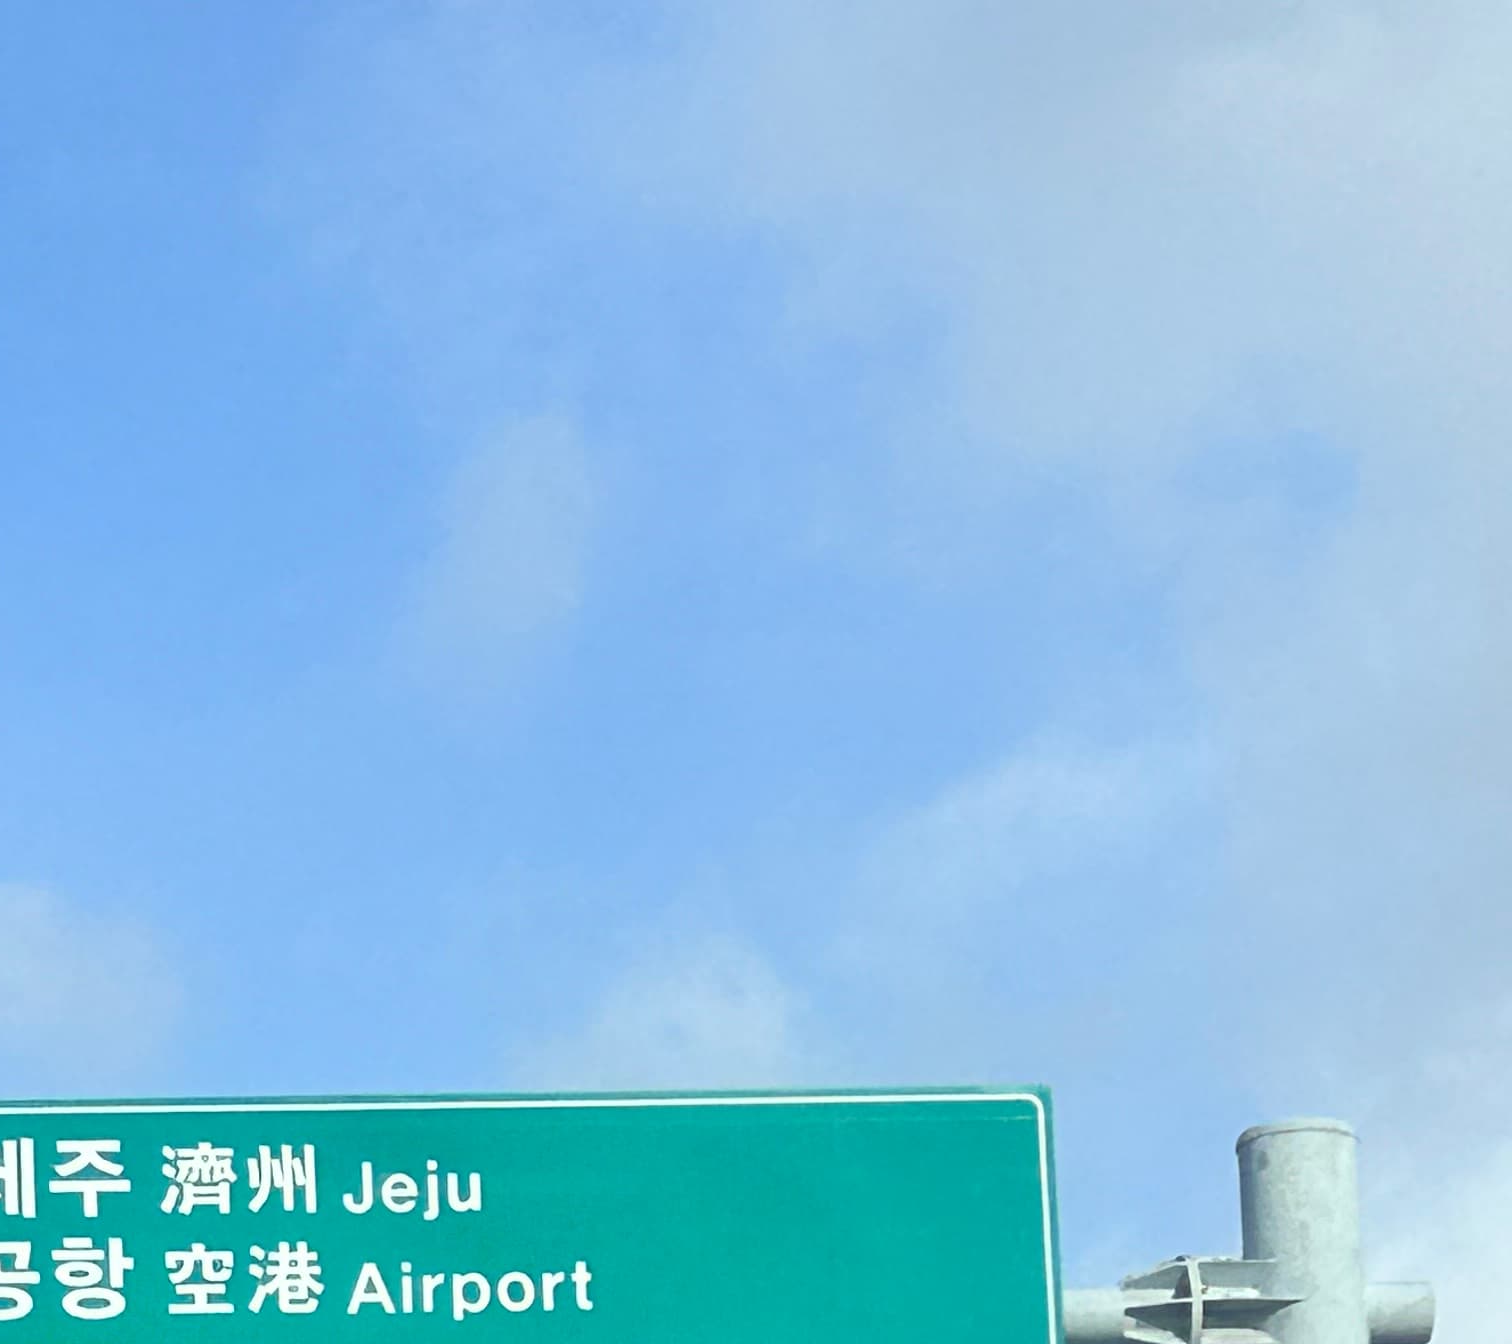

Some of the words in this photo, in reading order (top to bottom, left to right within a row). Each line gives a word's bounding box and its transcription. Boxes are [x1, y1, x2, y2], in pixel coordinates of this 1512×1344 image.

[160, 1141, 317, 1215] 濟州
[342, 1159, 482, 1221] Jeju
[164, 1241, 325, 1314] 空港
[347, 1260, 593, 1321] Airport
